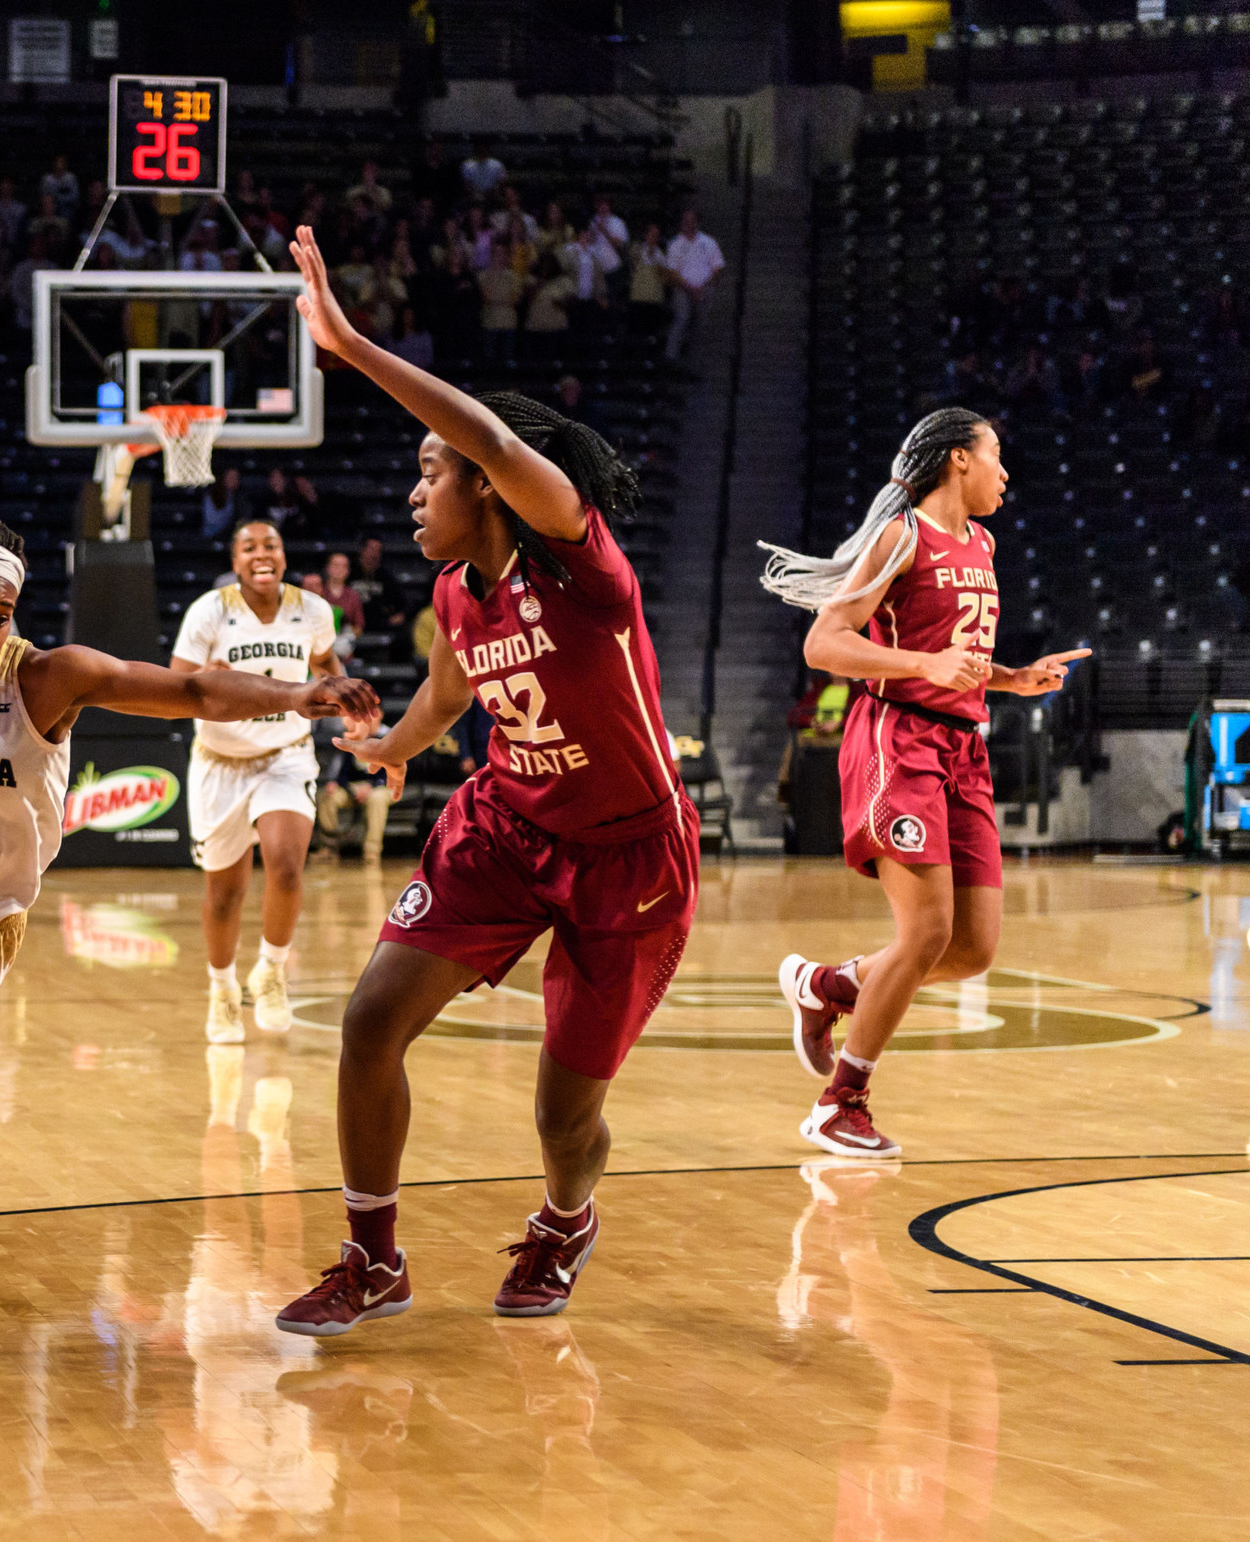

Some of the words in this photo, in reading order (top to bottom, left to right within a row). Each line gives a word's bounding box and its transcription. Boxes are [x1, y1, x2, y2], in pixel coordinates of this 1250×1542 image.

[142, 91, 163, 119] 4
[173, 91, 211, 122] 30
[132, 122, 201, 181] 26
[951, 592, 999, 648] 25
[228, 642, 304, 663] GEORGIA
[478, 671, 566, 744] 32
[509, 743, 589, 776] STATE
[62, 777, 168, 831] LIBMAN
